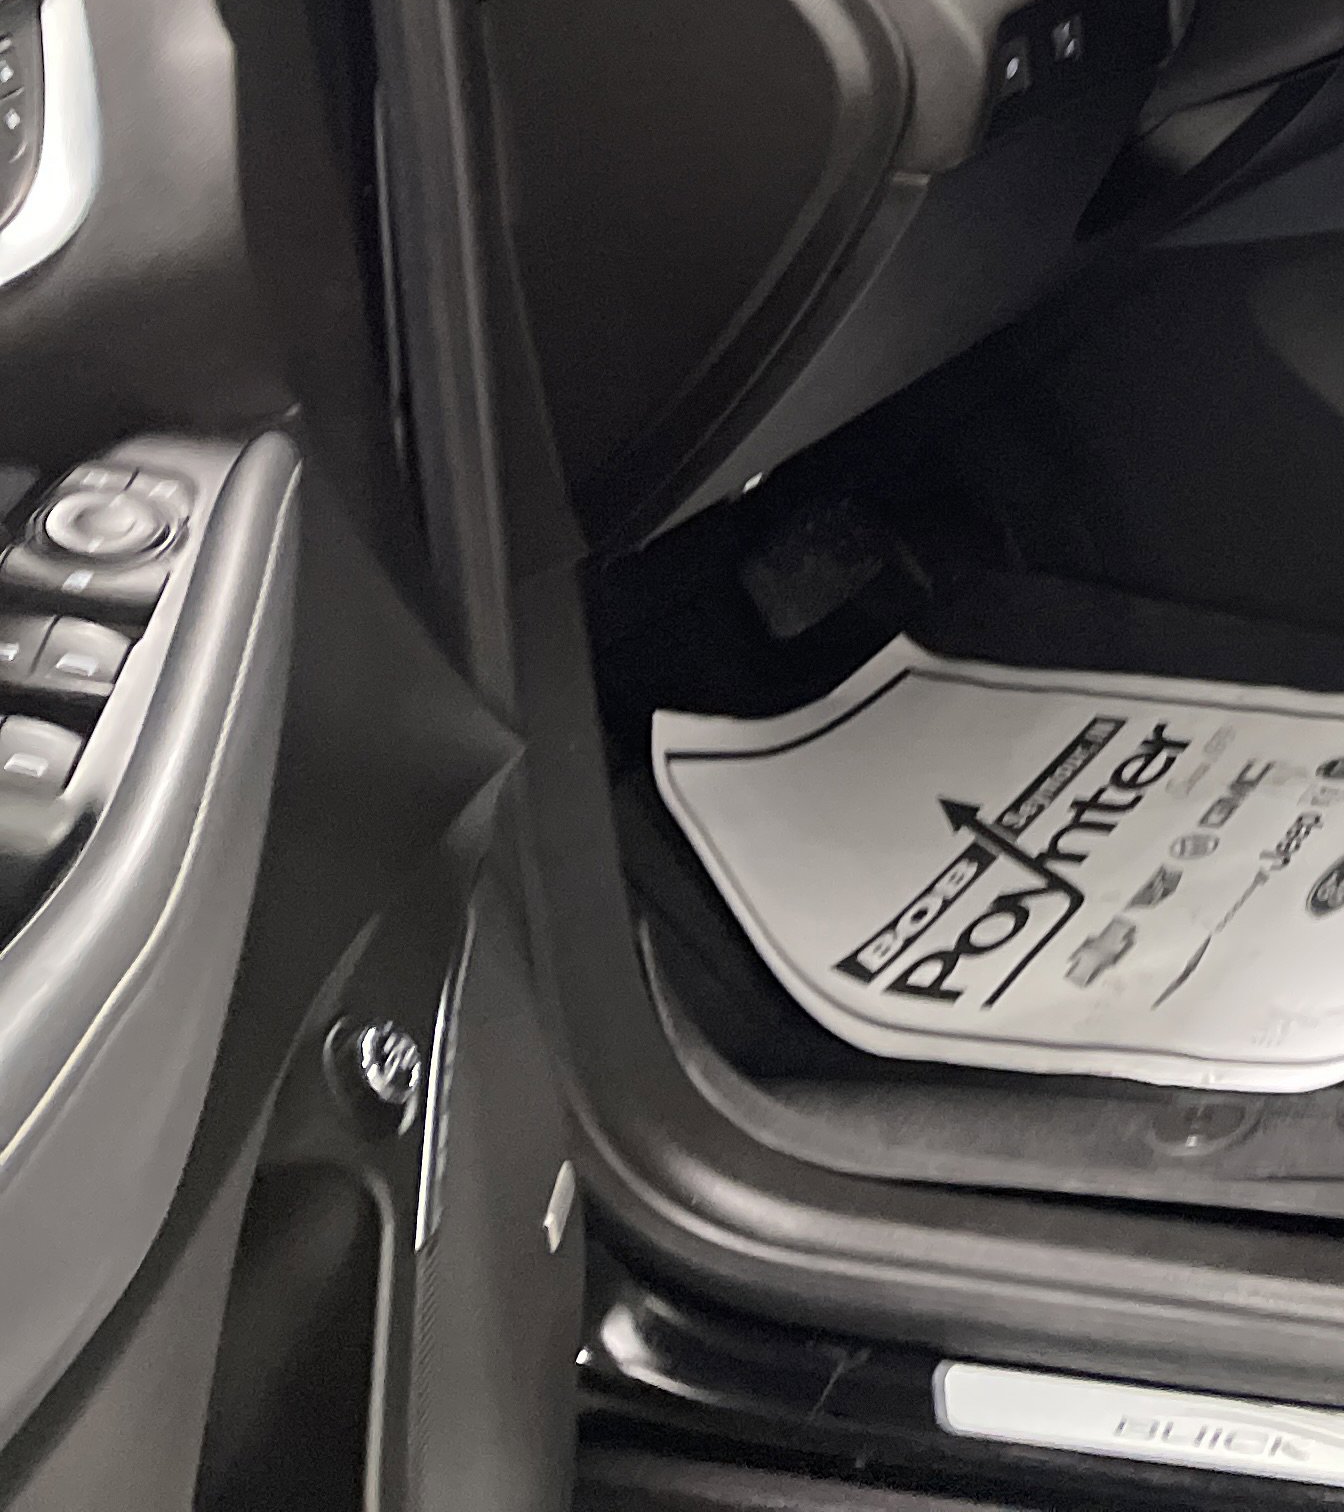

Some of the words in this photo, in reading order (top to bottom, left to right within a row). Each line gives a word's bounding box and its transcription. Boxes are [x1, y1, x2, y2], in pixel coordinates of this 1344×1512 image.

[1198, 758, 1275, 829] GMC
[882, 721, 1192, 1004] Poynter
[1259, 811, 1323, 872] Jeep
[854, 856, 979, 974] BOB
[1113, 1415, 1310, 1463] BUICK
